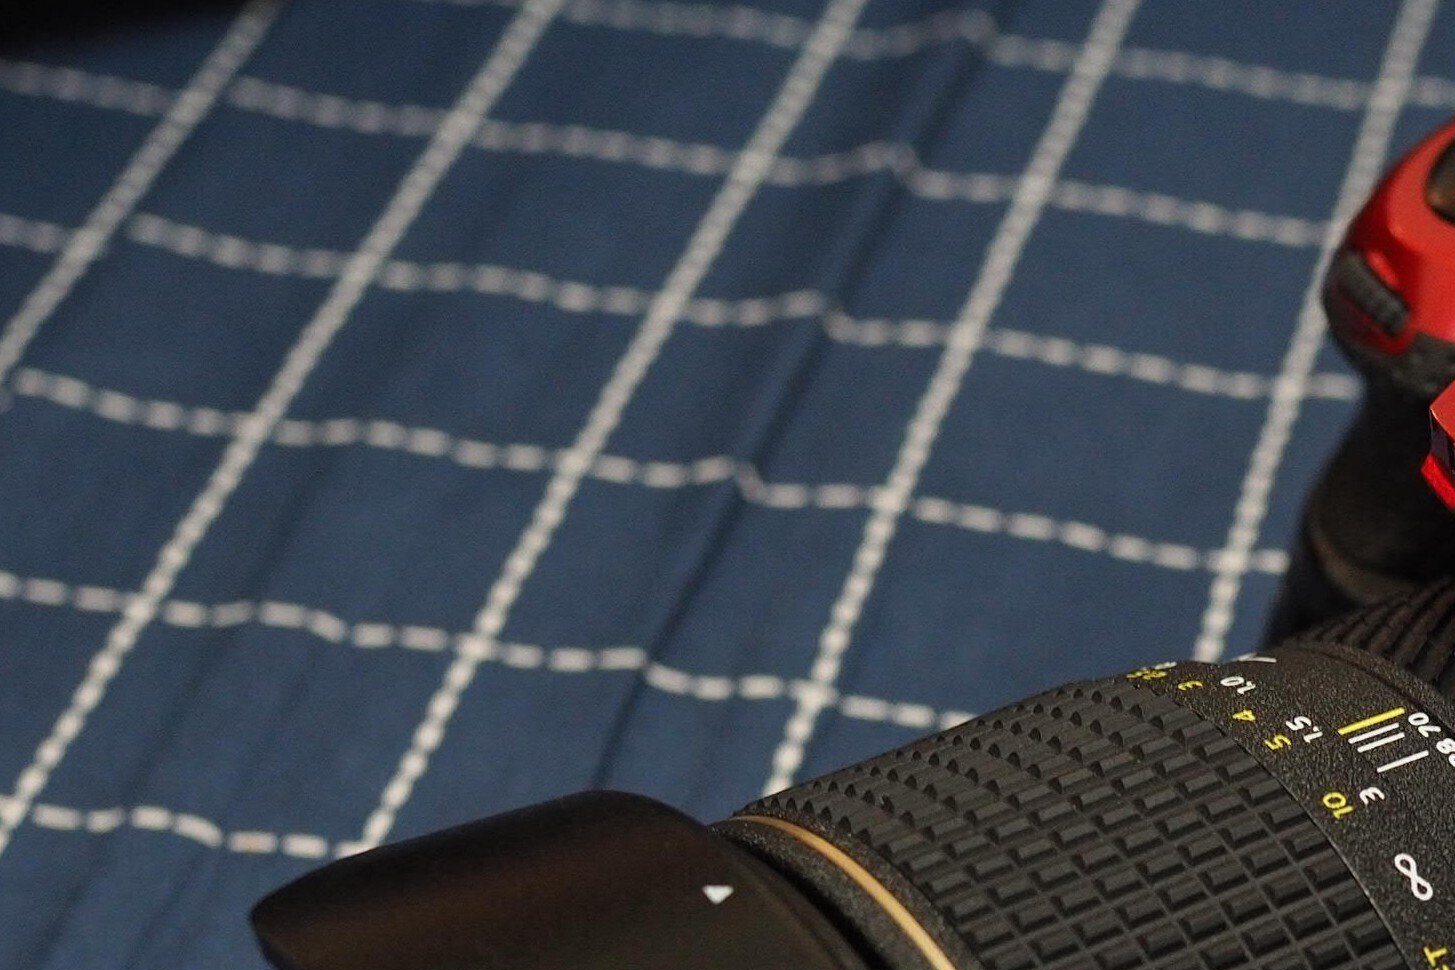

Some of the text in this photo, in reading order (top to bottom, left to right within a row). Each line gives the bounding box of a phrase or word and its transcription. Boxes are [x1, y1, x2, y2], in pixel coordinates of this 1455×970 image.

[1285, 715, 1323, 744] 1.5
[1264, 734, 1292, 751] 5
[1322, 791, 1354, 820] 10
[1359, 786, 1386, 805] 3
